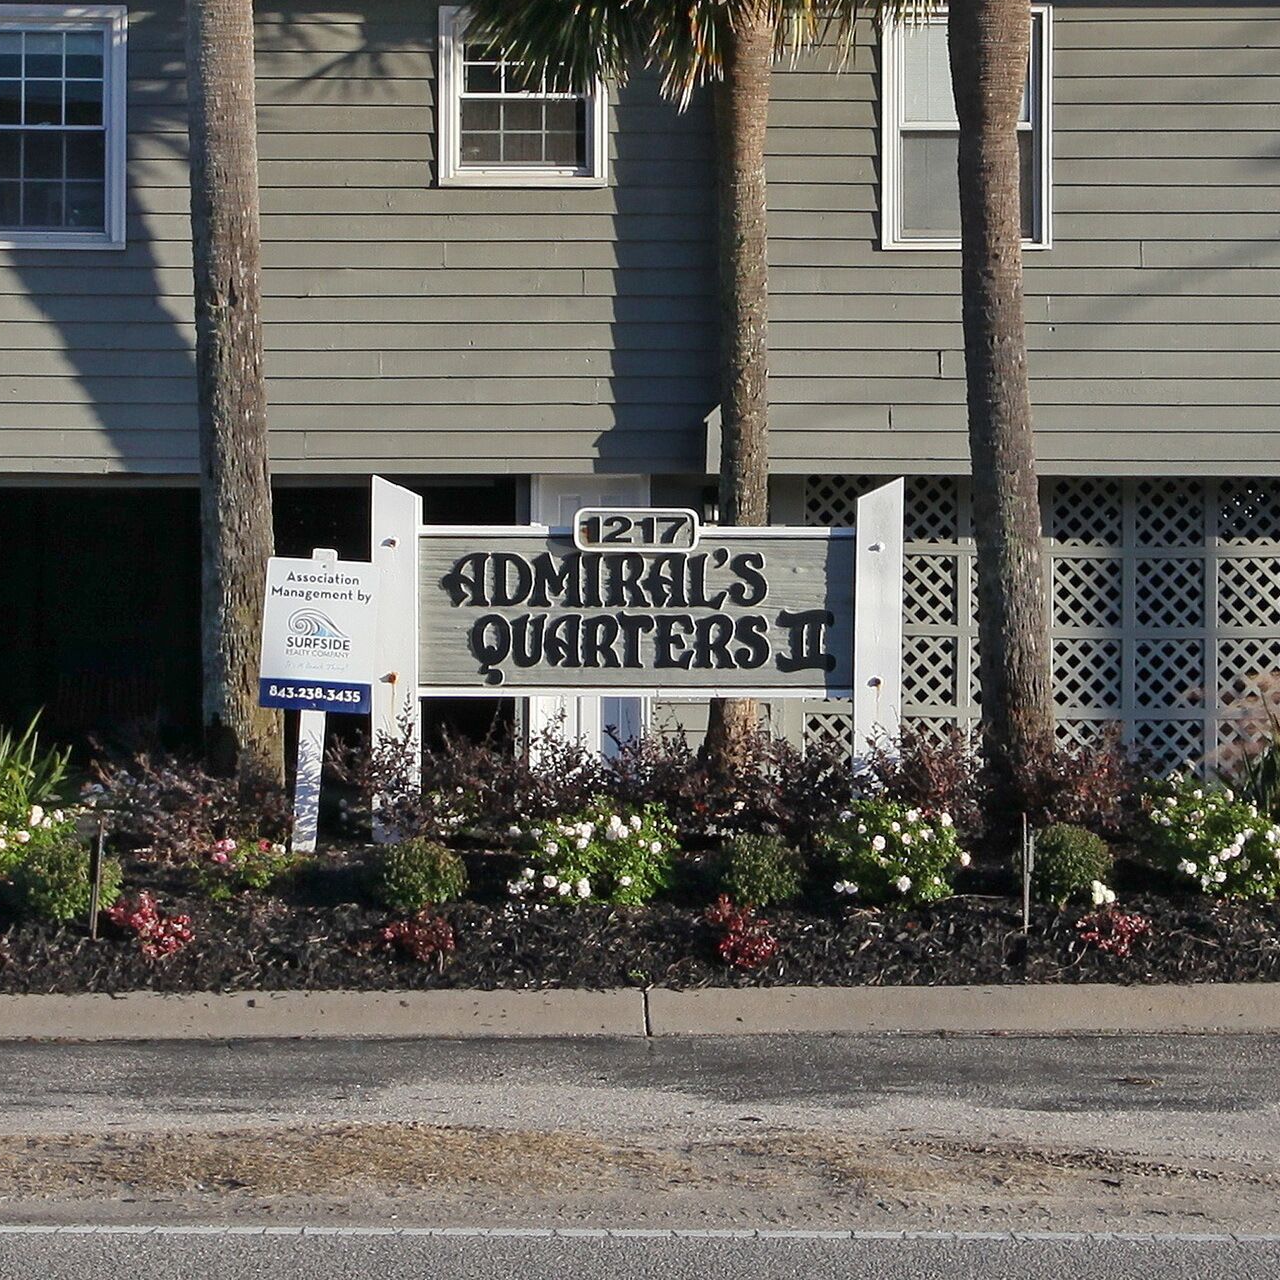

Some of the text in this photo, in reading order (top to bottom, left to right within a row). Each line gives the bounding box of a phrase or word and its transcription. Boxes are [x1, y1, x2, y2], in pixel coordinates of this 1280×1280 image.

[580, 516, 688, 543] 1217
[286, 571, 360, 585] Association
[441, 549, 767, 609] ADMIRAL'S
[271, 586, 372, 604] Management by
[286, 636, 351, 651] SURFSIDE
[471, 610, 836, 685] QUARTERS II
[311, 650, 350, 658] COMPANY
[269, 684, 361, 703] 843.238.3435
